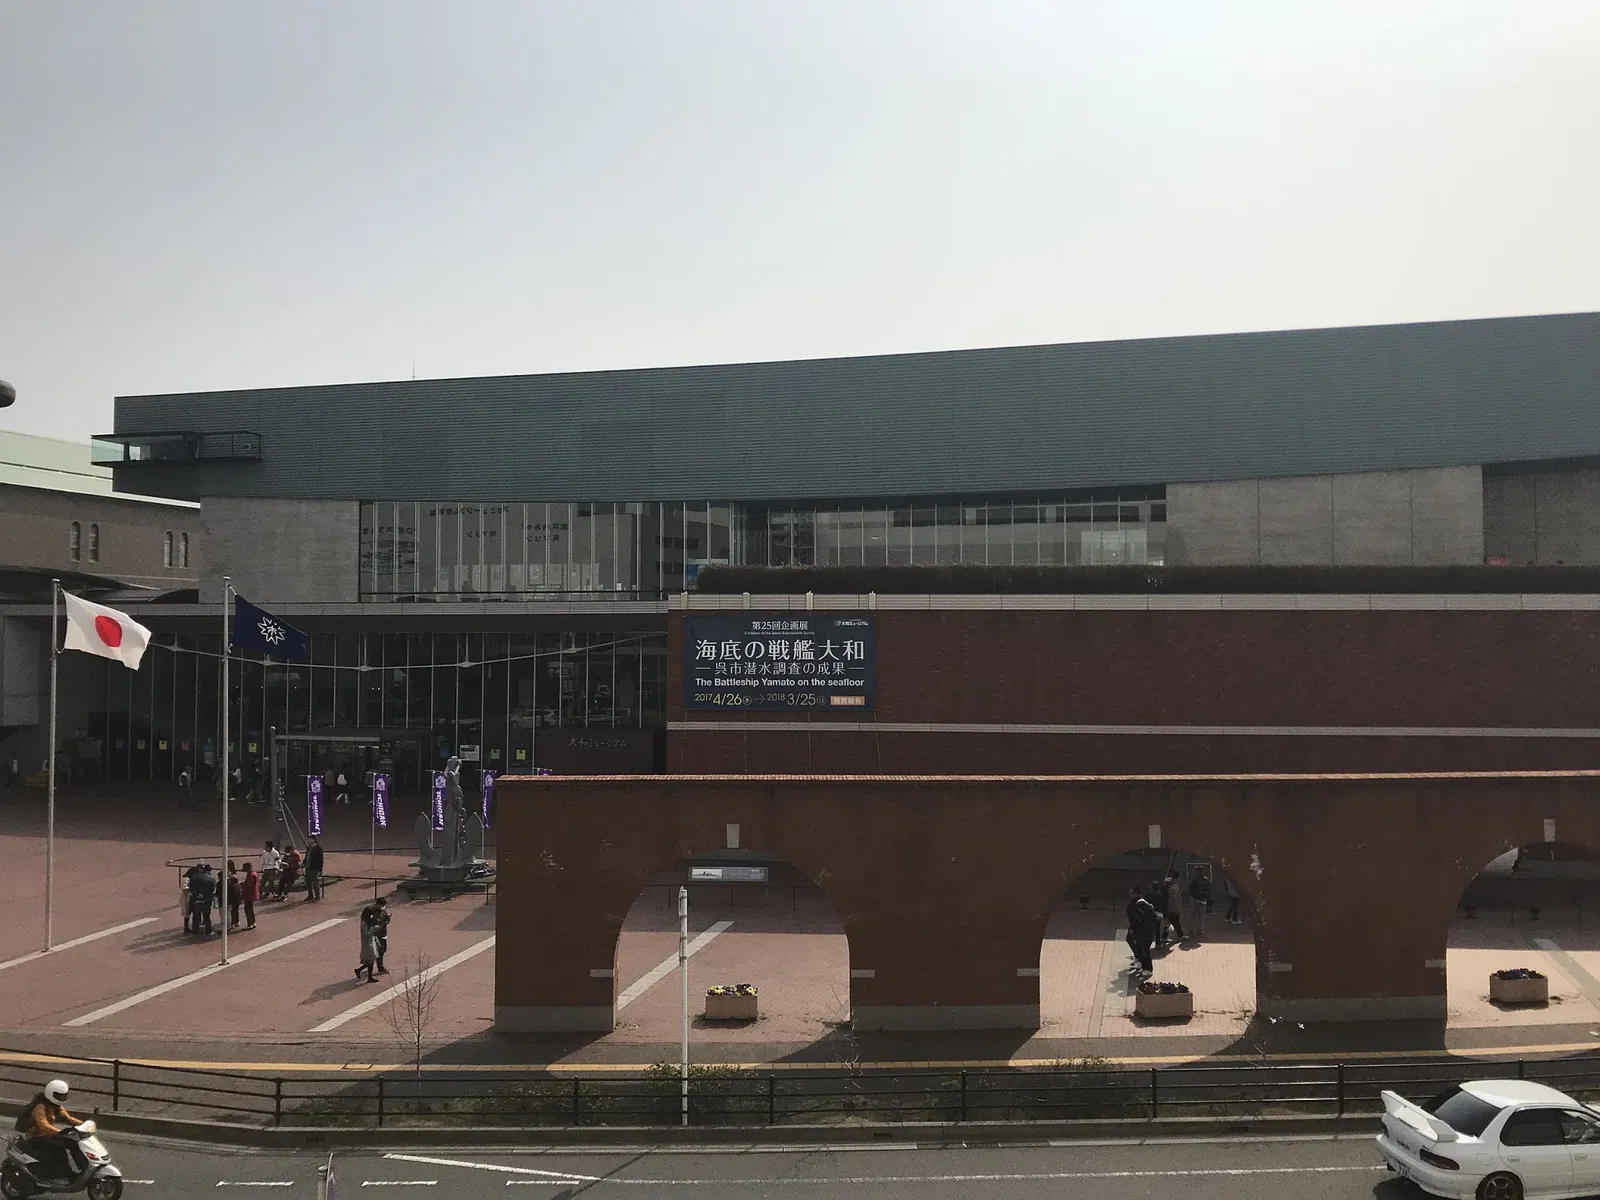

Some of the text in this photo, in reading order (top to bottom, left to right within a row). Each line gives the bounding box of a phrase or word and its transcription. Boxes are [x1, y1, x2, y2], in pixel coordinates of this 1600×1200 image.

[751, 620, 809, 631] 第25回企画展
[695, 639, 864, 661] 海底の戦艦大和
[714, 662, 846, 675] 呉市潜水調査の成果
[695, 678, 712, 686] The
[714, 678, 759, 687] Battleship
[761, 678, 795, 686] Yamato
[811, 678, 825, 686] the
[827, 678, 864, 686] seafloor
[694, 693, 713, 701] 2017
[713, 693, 742, 705] 4/26
[766, 693, 786, 701] 2018
[787, 693, 816, 705] 3/25
[568, 736, 627, 748] 大和ミュージアム
